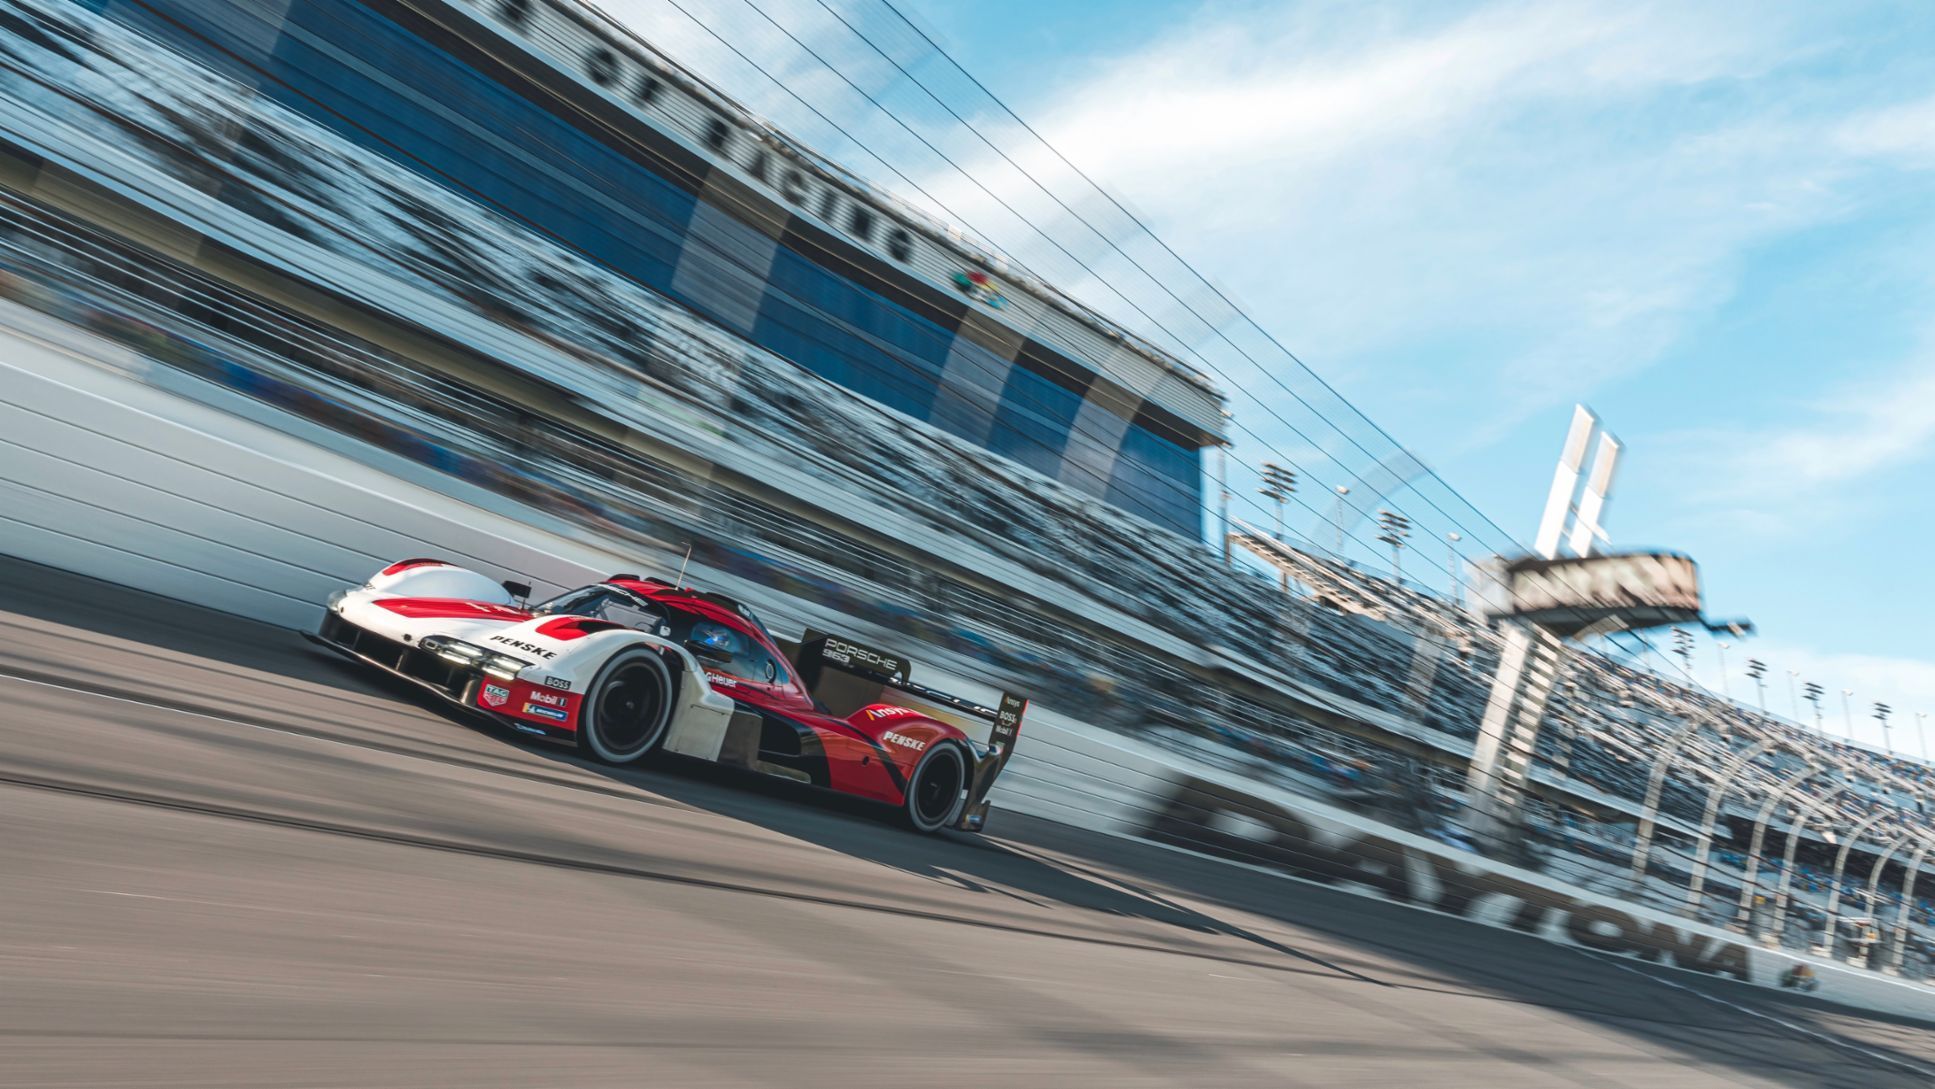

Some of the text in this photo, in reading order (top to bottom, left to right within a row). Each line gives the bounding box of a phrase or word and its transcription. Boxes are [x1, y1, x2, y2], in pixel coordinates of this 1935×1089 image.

[489, 635, 557, 660] PENSKE
[822, 648, 851, 664] 963
[824, 638, 898, 671] PORSCHE
[486, 685, 508, 698] TAG
[545, 677, 570, 689] BOSS
[530, 690, 558, 705] Mobil
[883, 730, 926, 752] PENSKE
[1140, 772, 1752, 984] DAYTONA
